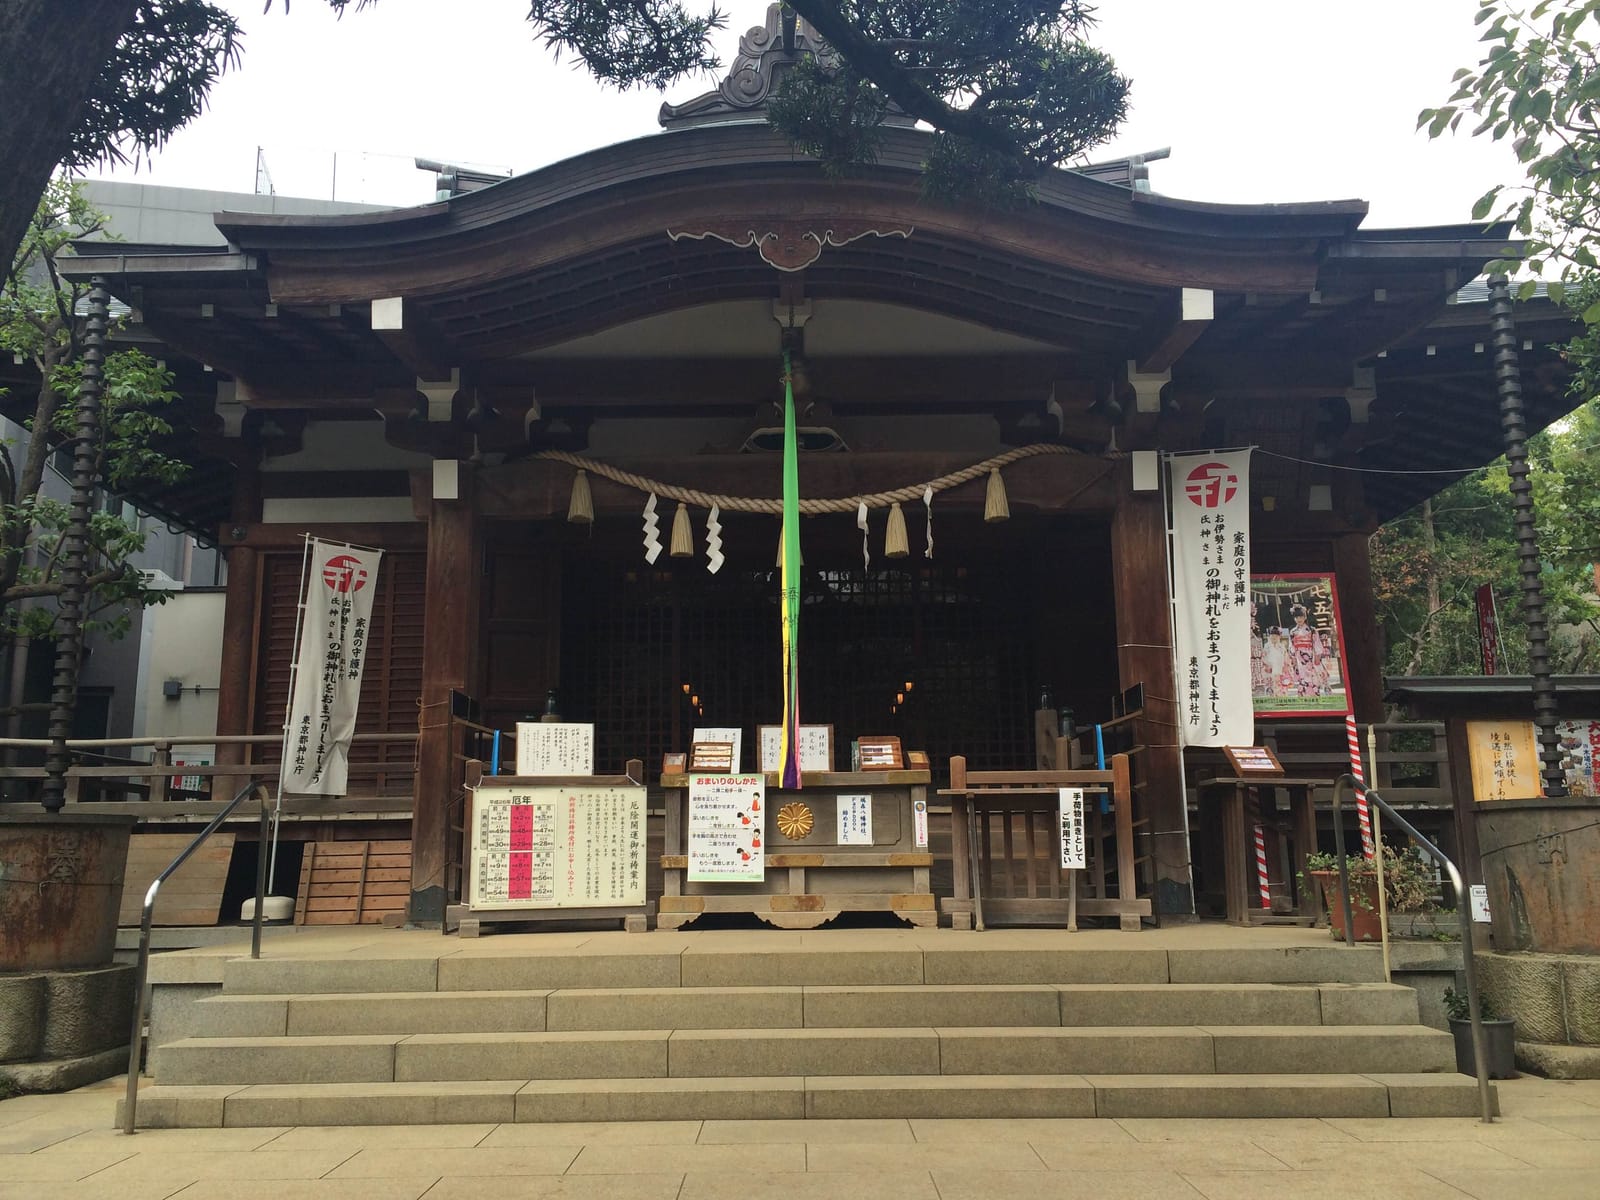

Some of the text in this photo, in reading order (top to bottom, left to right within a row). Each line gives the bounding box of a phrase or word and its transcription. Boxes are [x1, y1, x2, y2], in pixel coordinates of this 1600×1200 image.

[1200, 515, 1211, 565] 氏神さま
[1214, 514, 1225, 565] お伊勢さま
[1233, 531, 1246, 606] 家庭の守護神
[347, 617, 366, 680] 家庭の守護神
[1188, 656, 1200, 726] 東京都神社庁
[294, 715, 310, 775] 東京都神社庁
[512, 795, 532, 804] 厄年
[696, 777, 758, 786] おまいりのしかた
[1062, 812, 1072, 864] ご利用下さい
[1073, 792, 1084, 862] 手荷物置きとして
